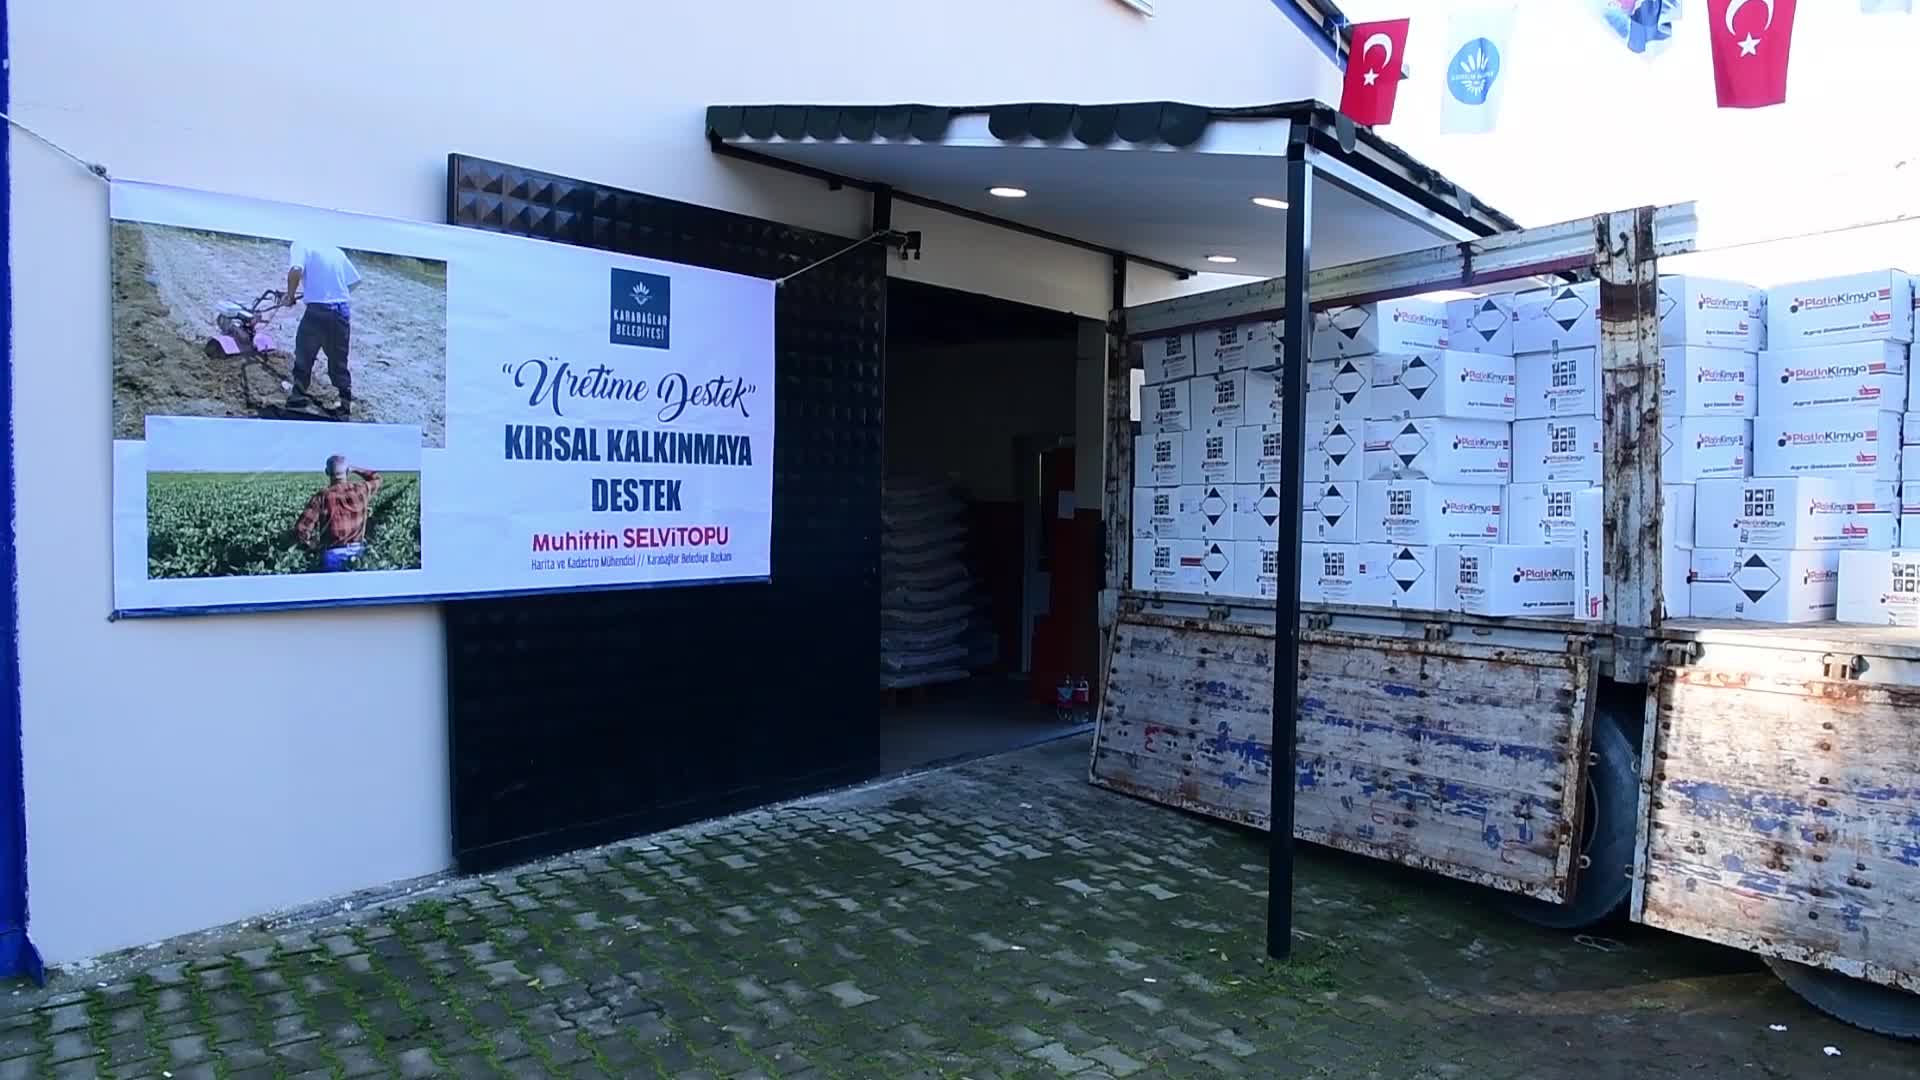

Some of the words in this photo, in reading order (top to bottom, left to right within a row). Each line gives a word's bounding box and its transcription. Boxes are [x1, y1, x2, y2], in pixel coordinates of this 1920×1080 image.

[1804, 290, 1877, 307] PlatinKimya
[616, 323, 664, 340] BELEDİYESİ
[1795, 364, 1868, 379] PlatinKimya
[505, 424, 601, 462] KIRSAL
[607, 428, 753, 466] KALKINMAYA
[1792, 431, 1864, 443] PlatinKimya
[592, 478, 682, 512] DESTEK
[532, 529, 618, 552] Muhittin
[531, 559, 555, 570] Harita
[557, 559, 566, 570] ve
[567, 557, 599, 569] Kadastro
